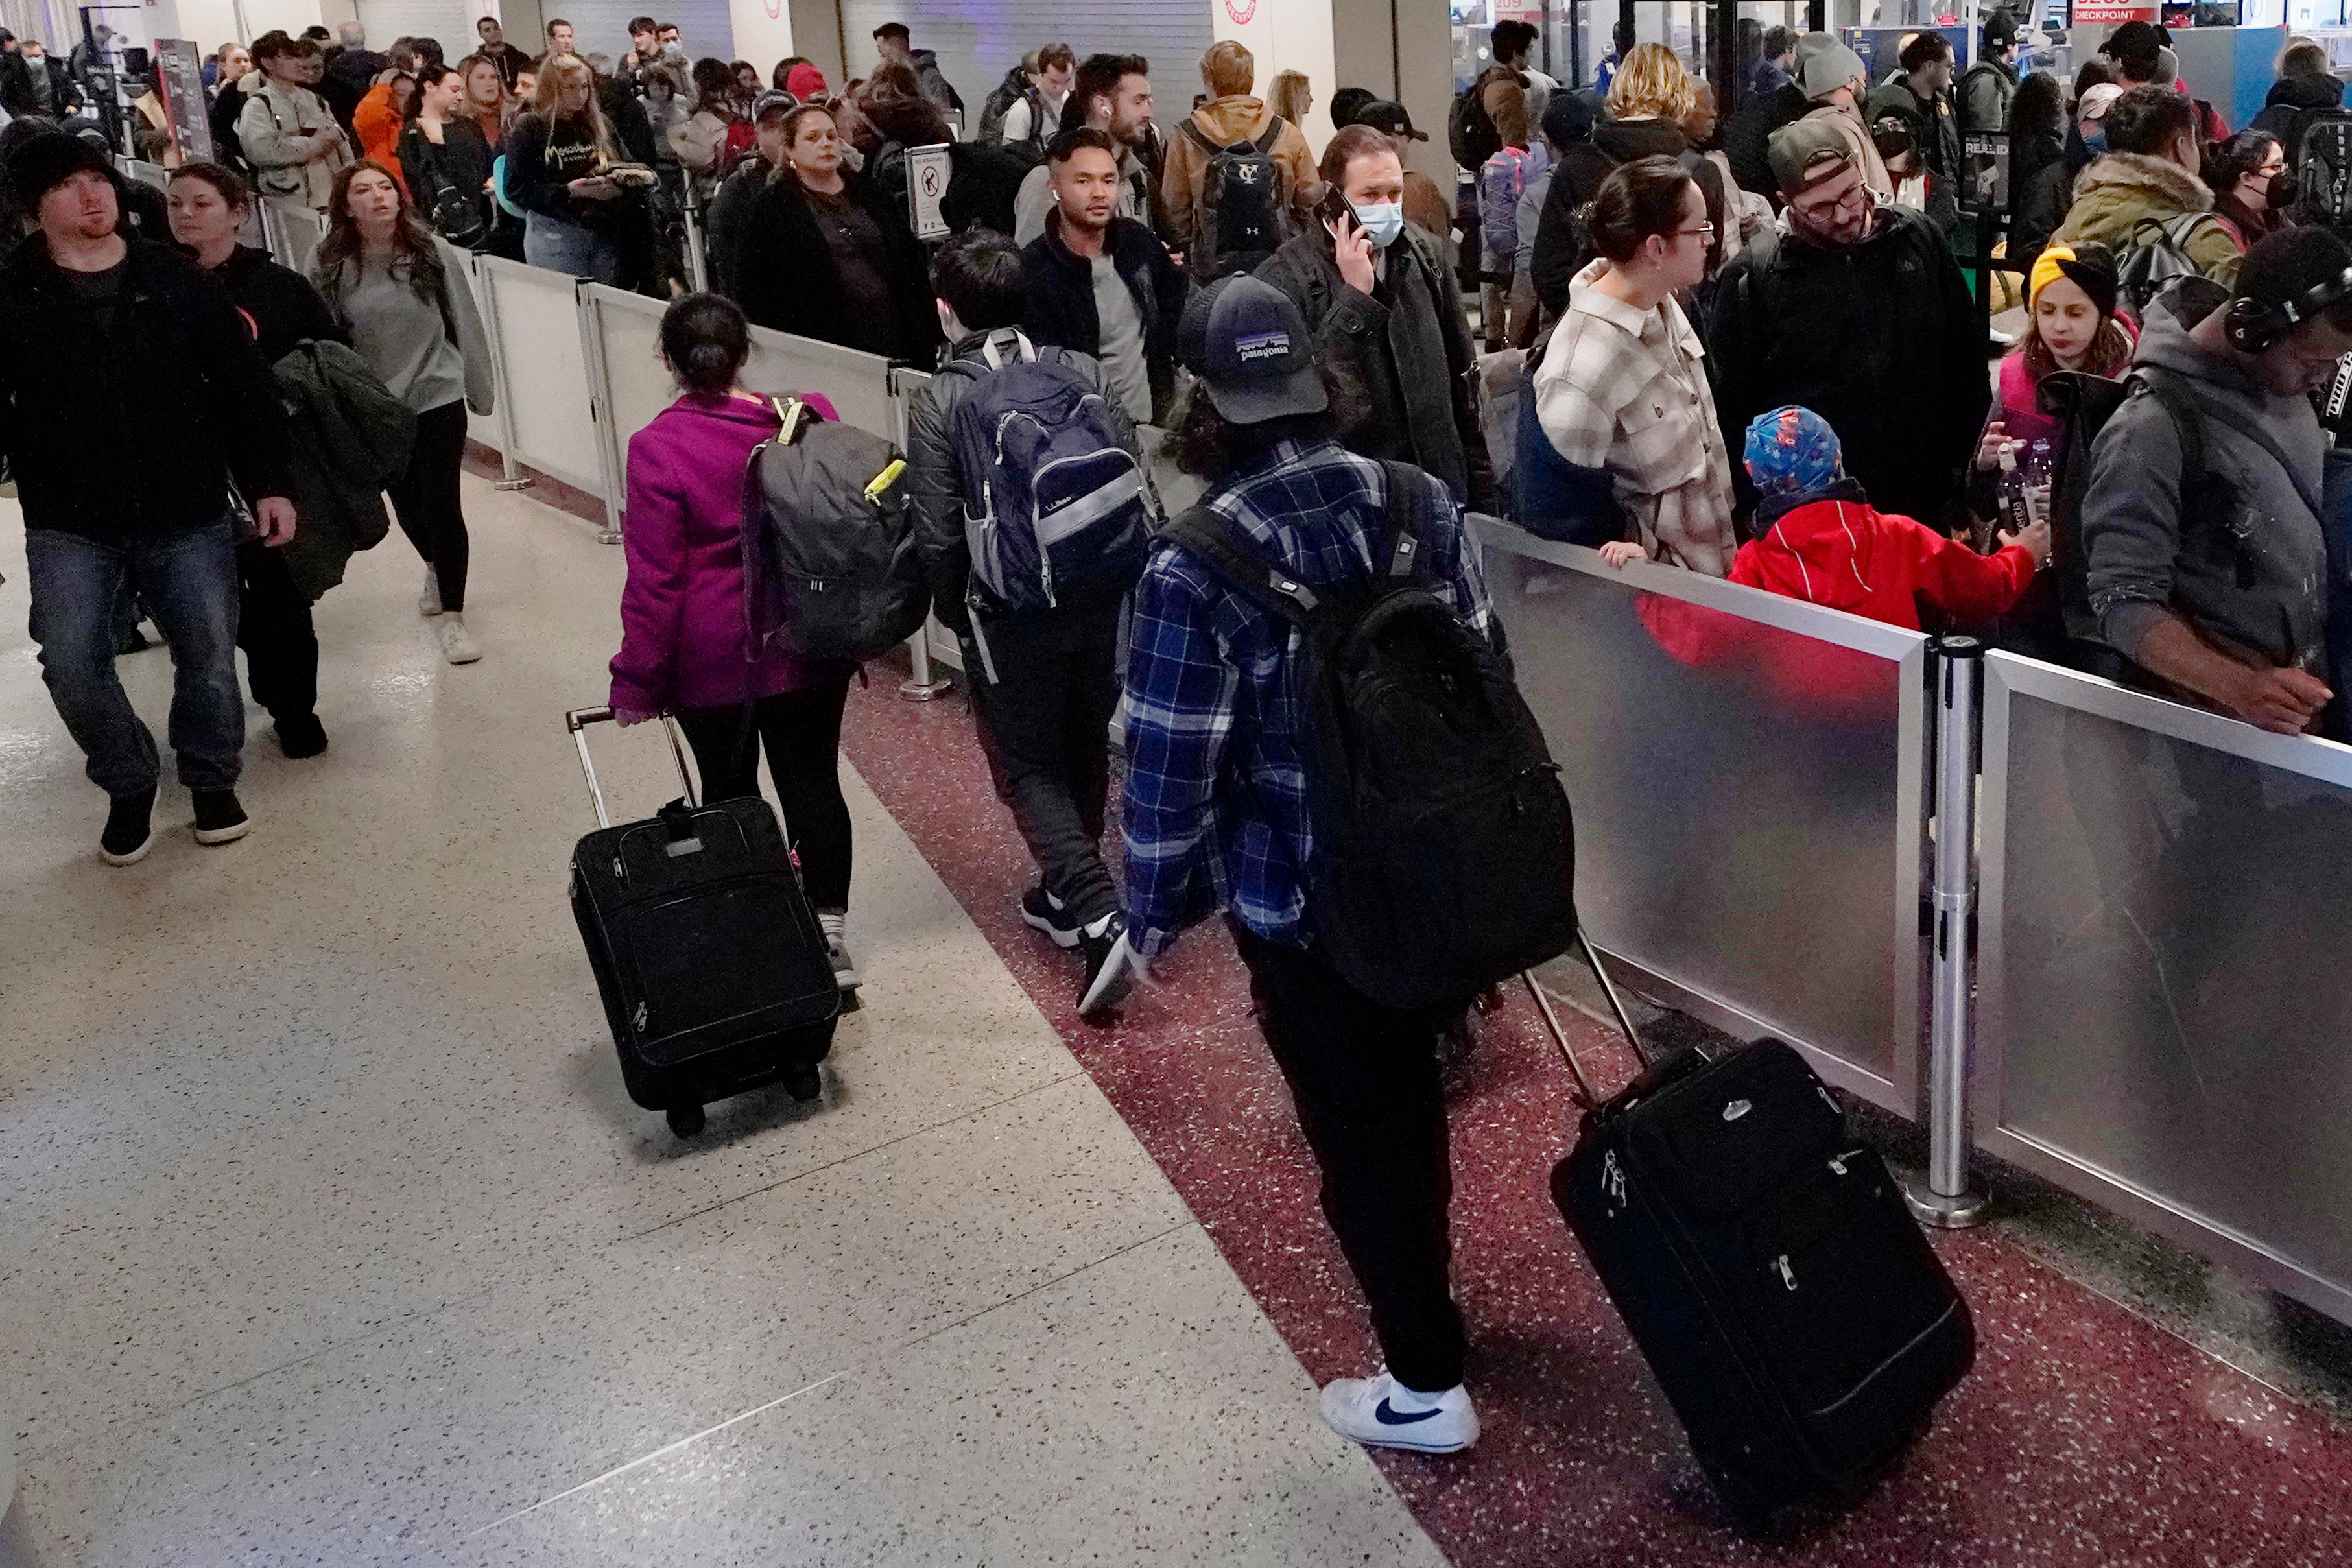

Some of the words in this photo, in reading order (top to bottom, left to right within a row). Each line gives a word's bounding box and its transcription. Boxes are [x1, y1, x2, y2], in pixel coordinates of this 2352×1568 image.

[2075, 10, 2135, 19] CHECKPOINT
[1241, 346, 1289, 361] patagonia
[2012, 501, 2026, 531] entia
